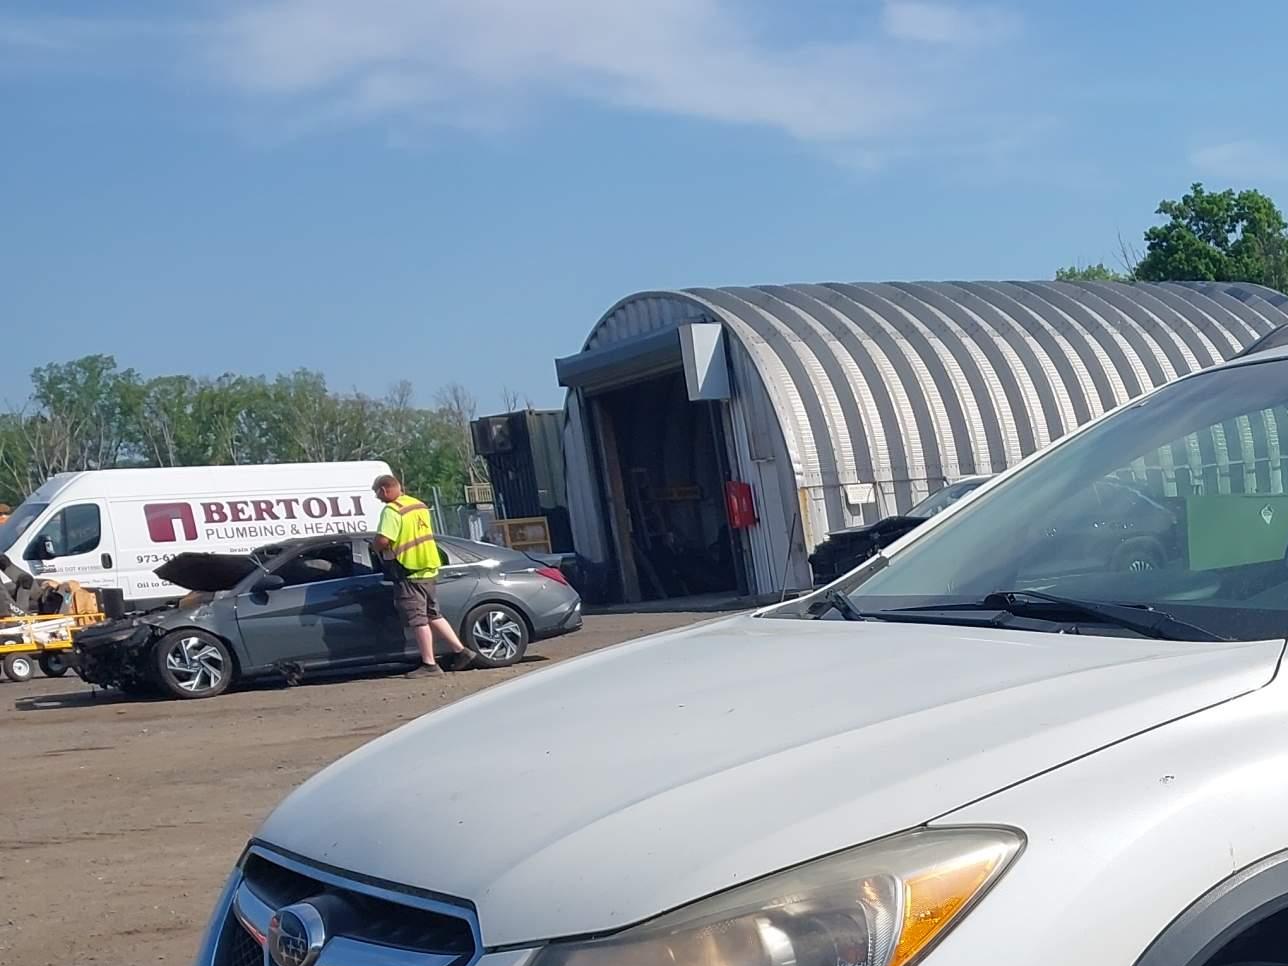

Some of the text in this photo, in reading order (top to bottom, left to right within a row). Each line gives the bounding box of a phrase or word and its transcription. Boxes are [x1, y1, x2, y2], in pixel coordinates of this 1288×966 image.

[200, 496, 366, 524] BERTOLI
[205, 520, 368, 540] PLUMBING & HEATING
